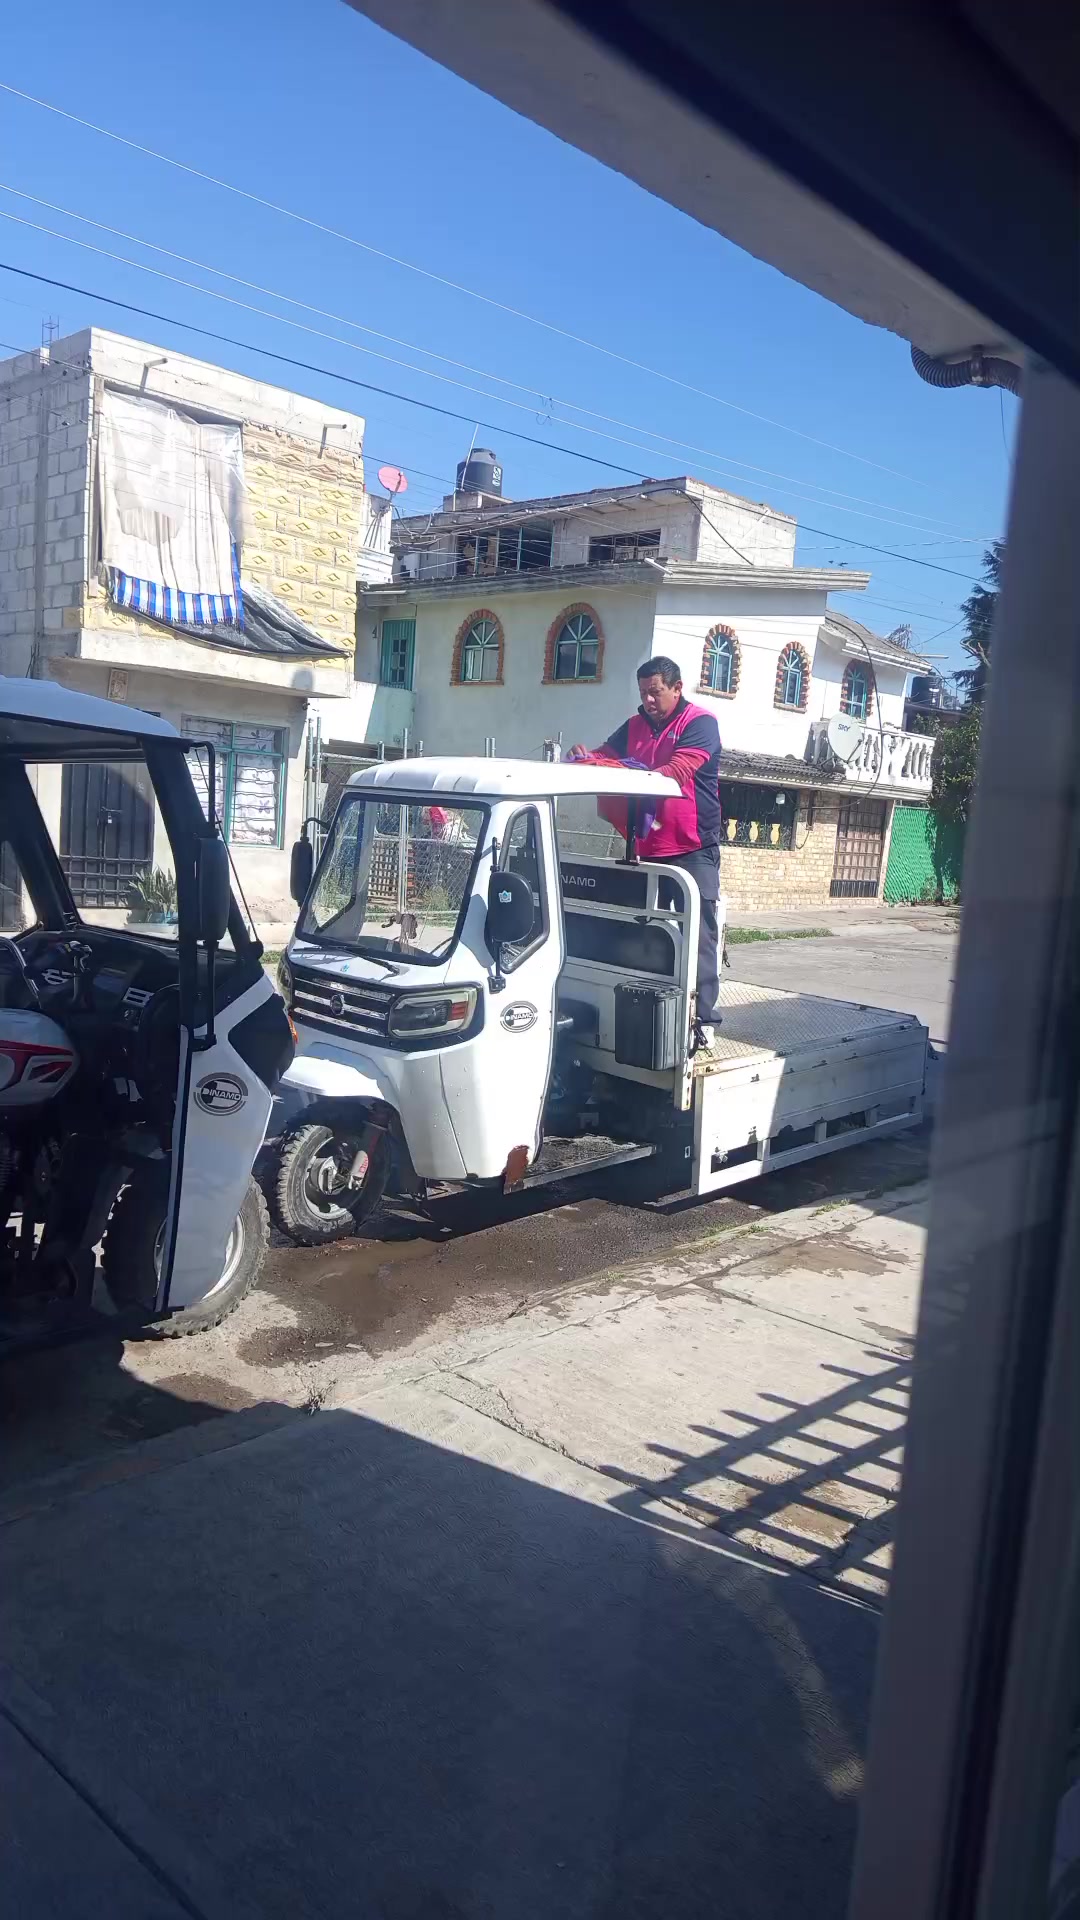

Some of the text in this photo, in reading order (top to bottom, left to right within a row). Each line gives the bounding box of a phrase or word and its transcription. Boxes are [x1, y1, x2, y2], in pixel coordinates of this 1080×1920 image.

[838, 723, 851, 732] SKY
[560, 874, 596, 888] NAMO
[505, 1012, 533, 1021] DINAMO
[202, 1087, 241, 1101] DINAMO
